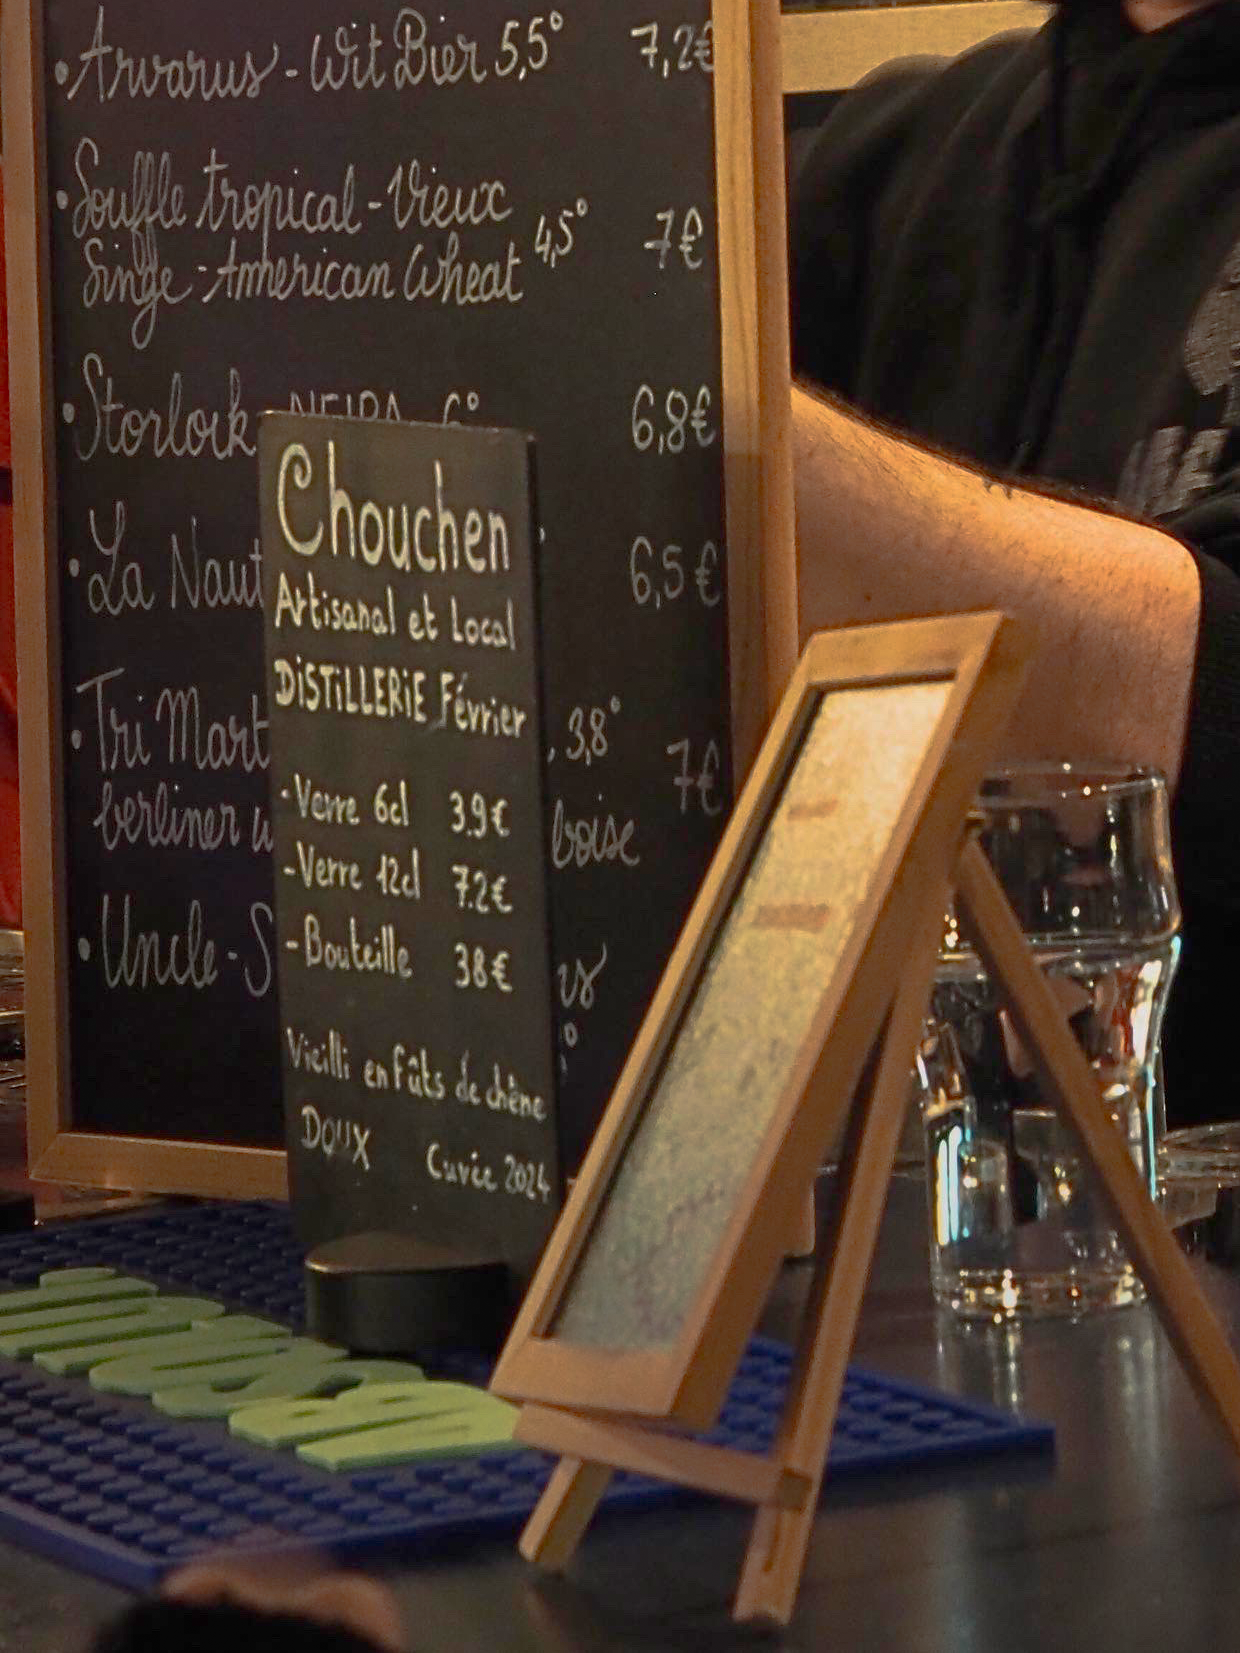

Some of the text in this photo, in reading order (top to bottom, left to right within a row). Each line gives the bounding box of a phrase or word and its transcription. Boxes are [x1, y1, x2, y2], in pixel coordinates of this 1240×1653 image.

[72, 136, 187, 283] Souffle
[196, 147, 363, 272] tropical
[403, 233, 525, 307] Wheat
[277, 439, 510, 573] Chouchen
[88, 500, 156, 616] La
[275, 571, 516, 650] Artisanal et Local
[75, 667, 151, 773] Tri
[438, 671, 528, 739] Février
[294, 773, 361, 826] Verre
[374, 779, 410, 827] 6cl
[666, 737, 722, 816] 7€
[296, 840, 363, 891] Verre
[375, 846, 421, 900] 12cl
[303, 913, 514, 994] Bouteille 38€
[286, 1025, 352, 1082] Vieilli
[363, 1059, 389, 1090] en
[455, 1050, 481, 1105] de
[425, 1142, 498, 1193] Cuvée
